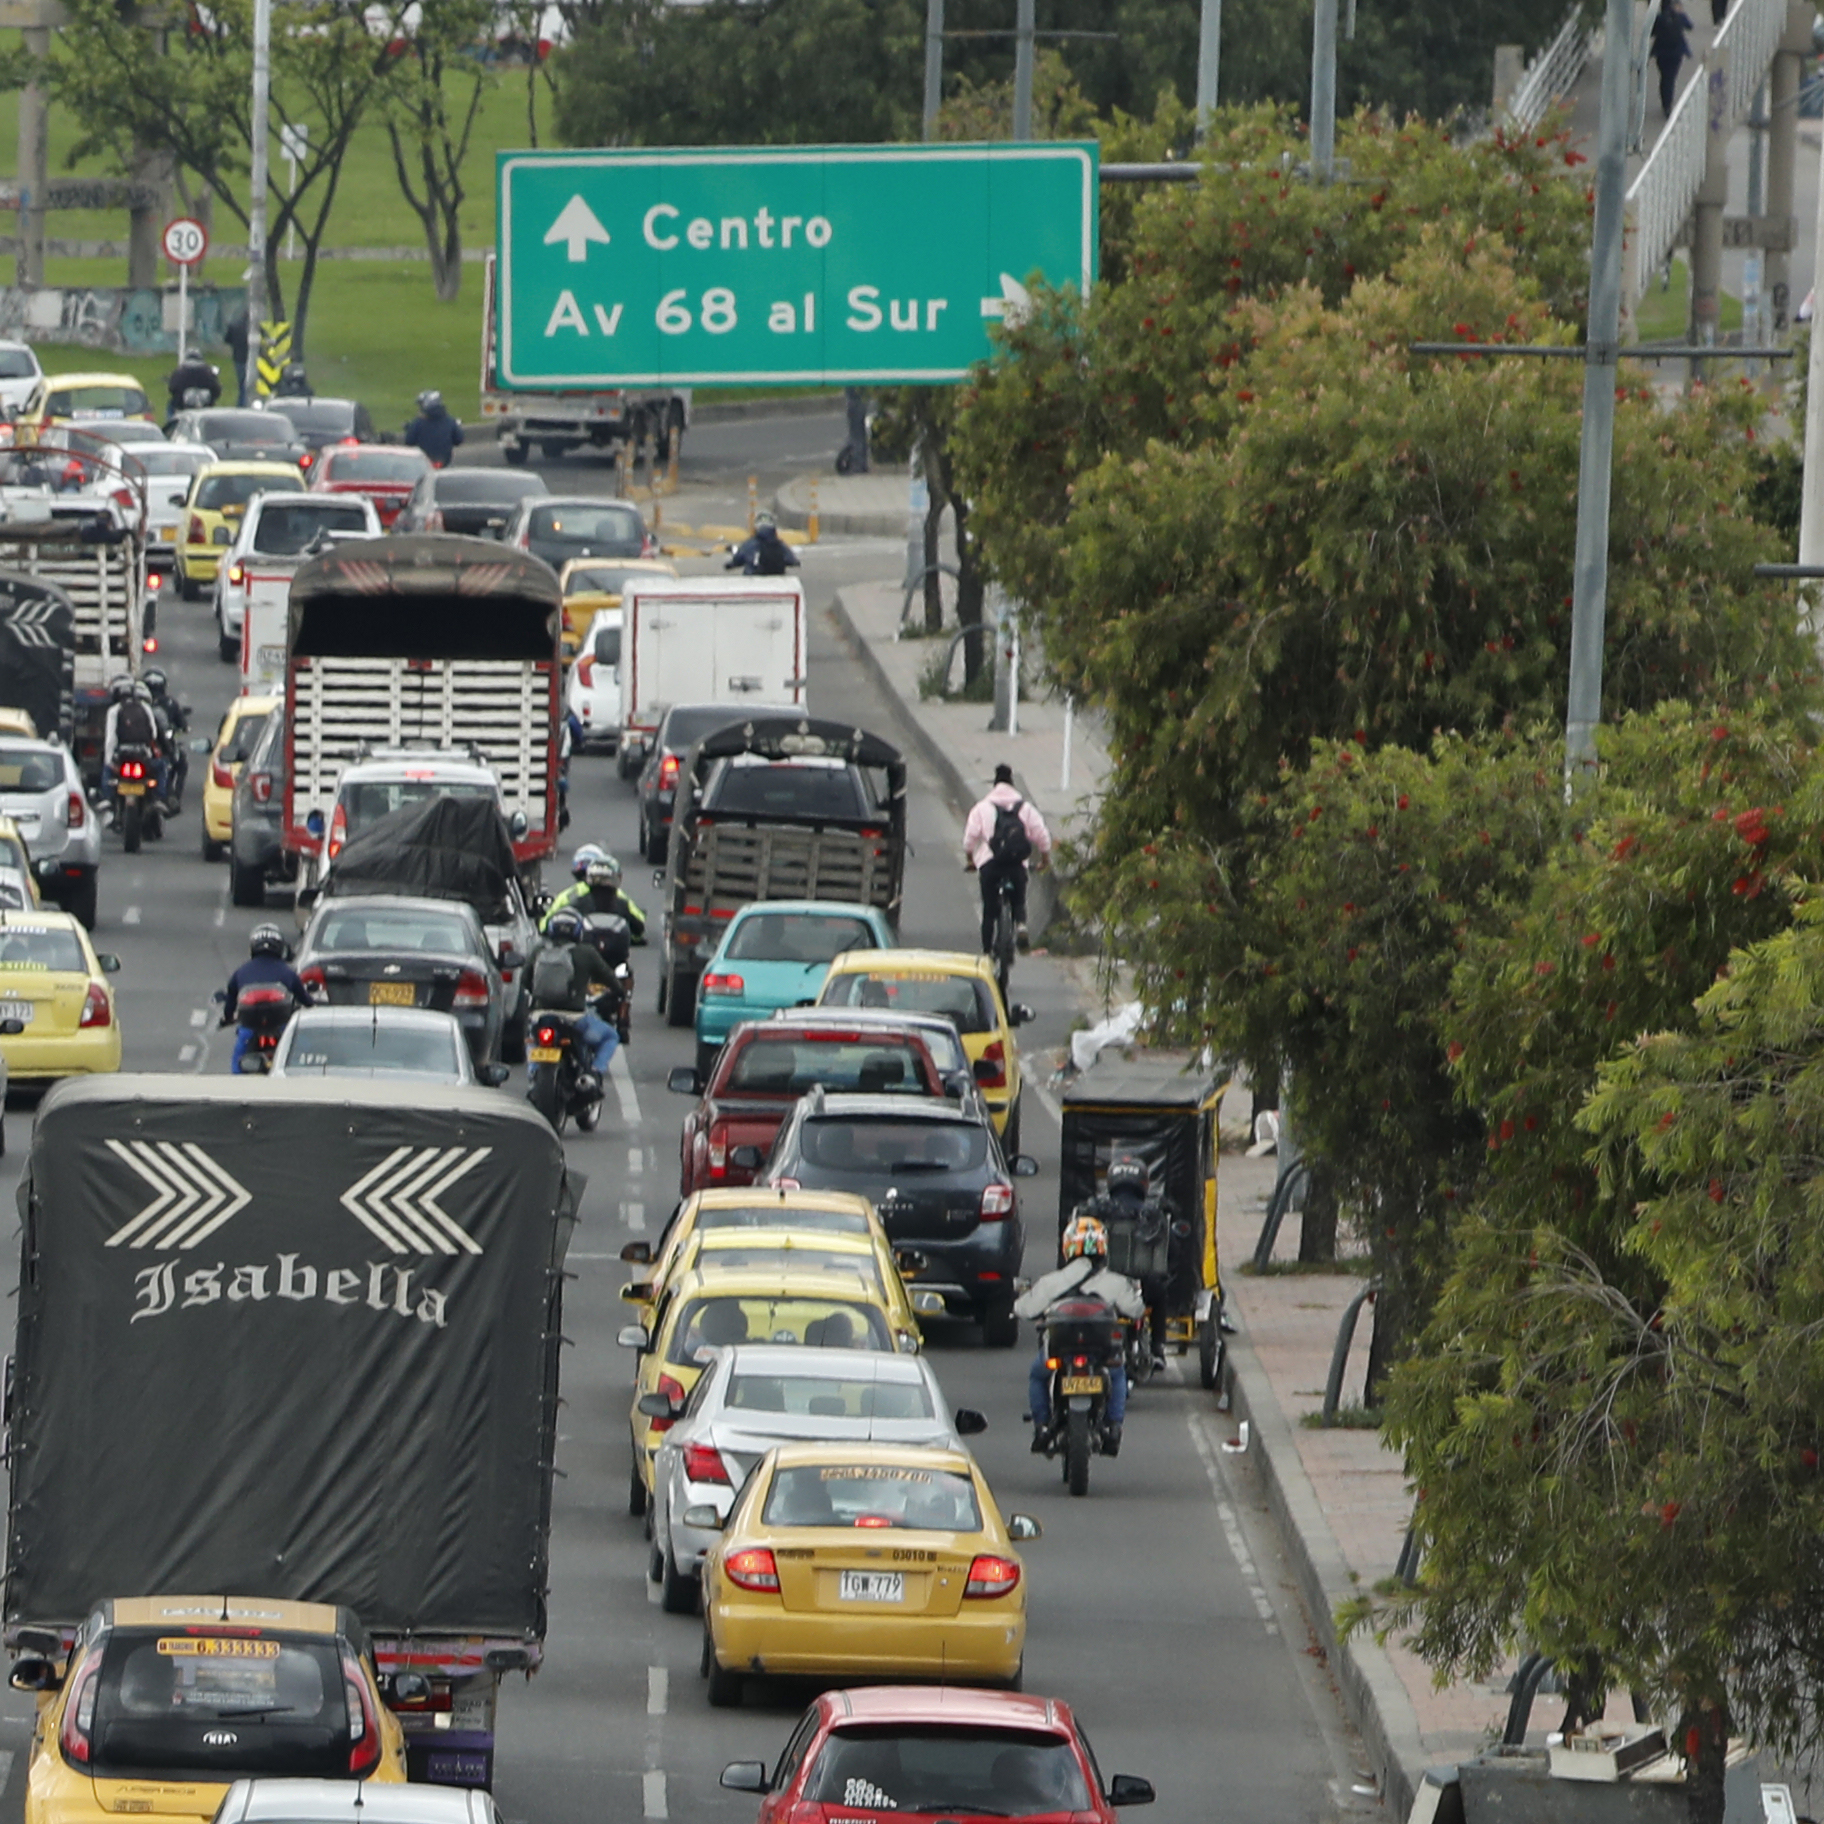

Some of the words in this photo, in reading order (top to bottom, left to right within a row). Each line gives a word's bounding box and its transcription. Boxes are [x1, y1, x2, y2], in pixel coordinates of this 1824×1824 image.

[172, 230, 199, 253] 30
[643, 203, 834, 250] Centro
[545, 289, 625, 336] Av
[654, 287, 739, 336] 68
[768, 293, 817, 333] al
[846, 284, 949, 331] Sur
[130, 1253, 448, 1328] Isabella
